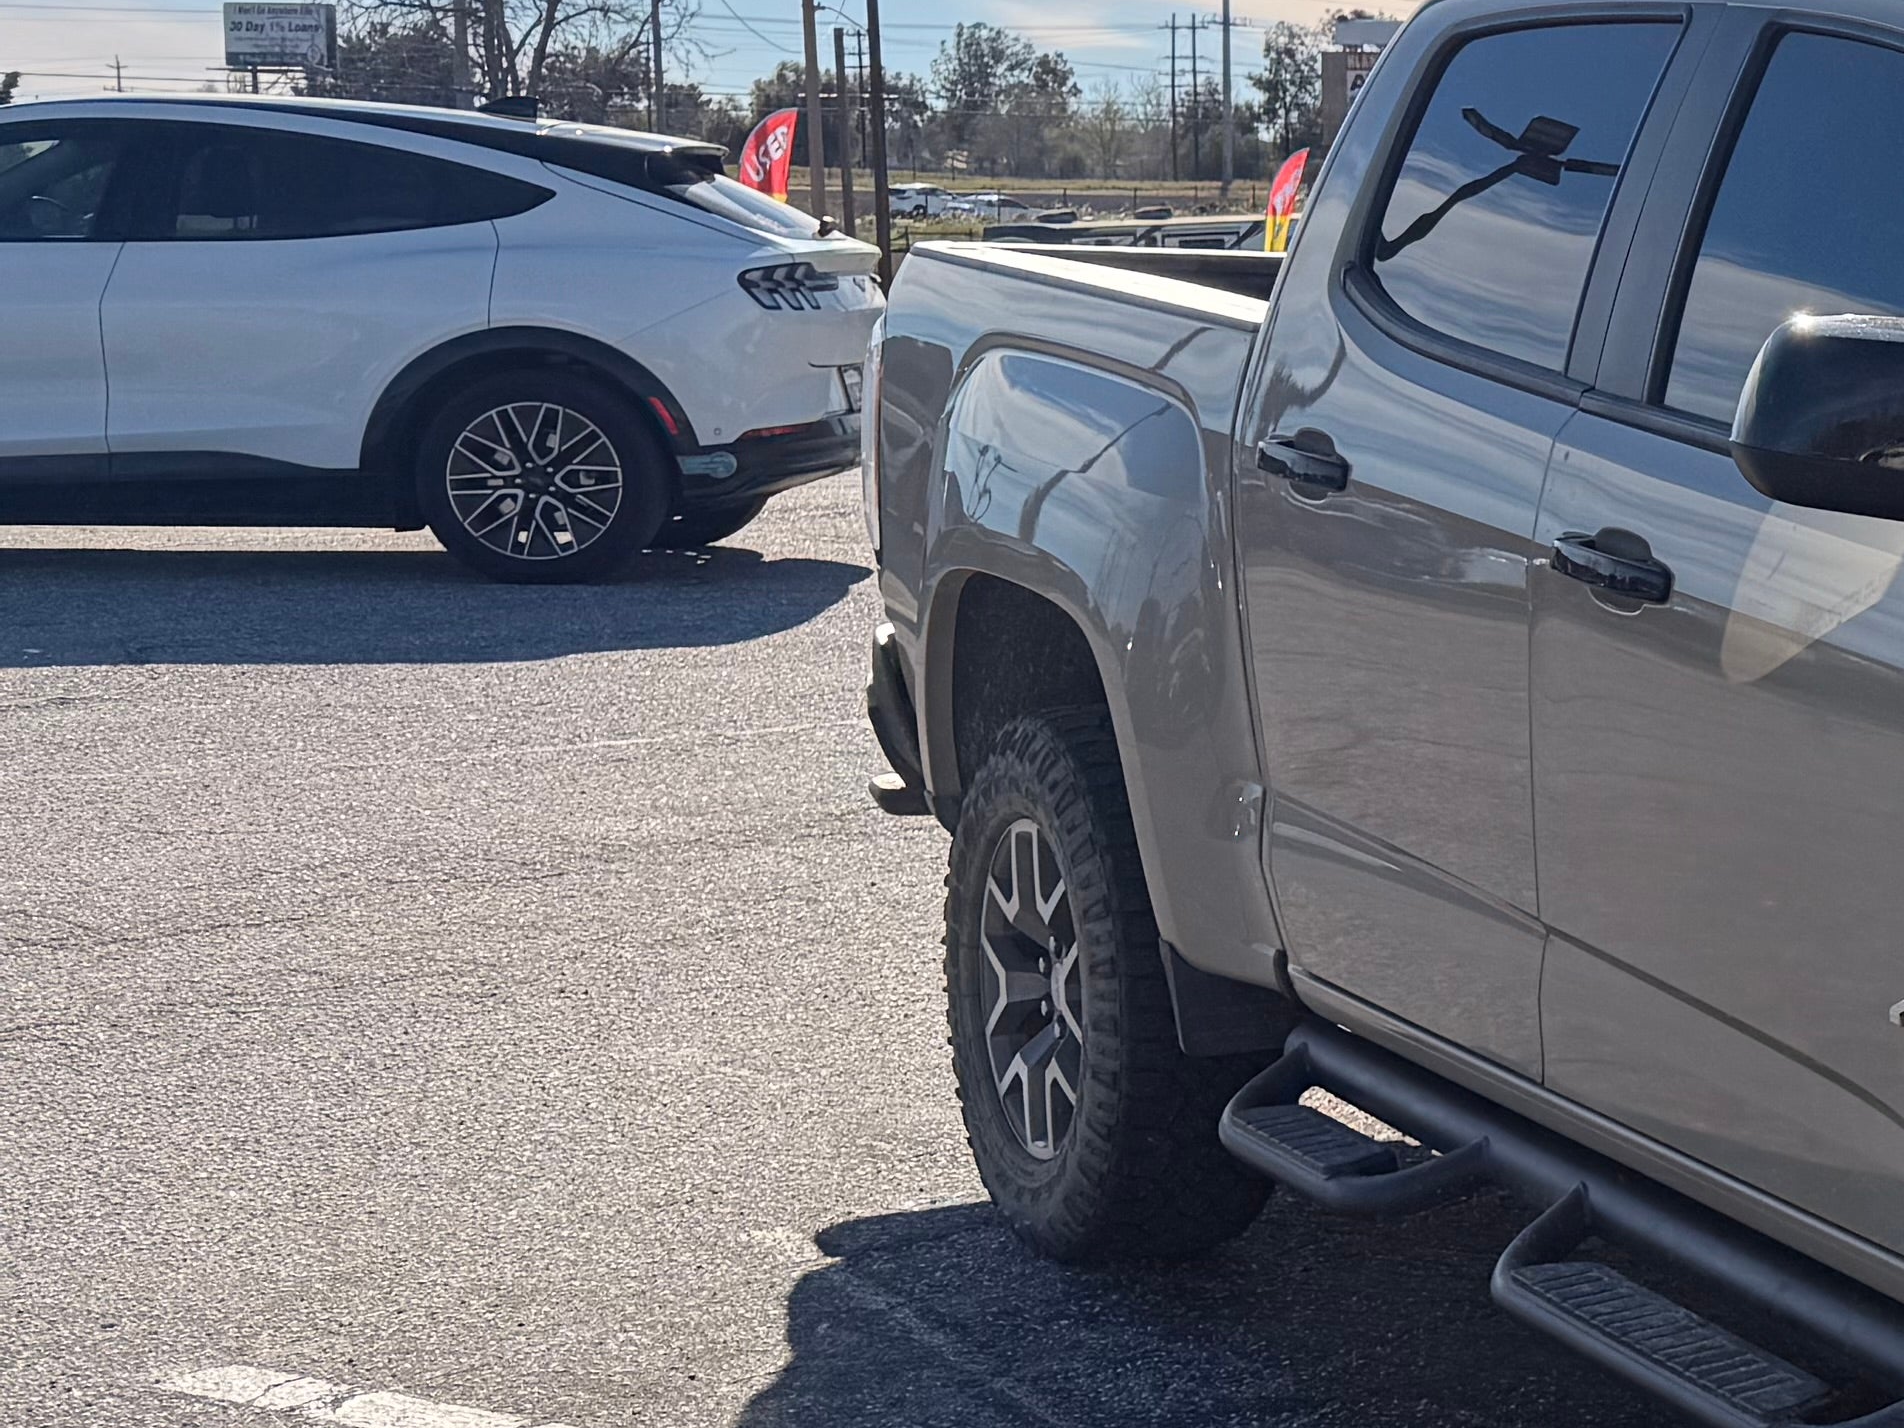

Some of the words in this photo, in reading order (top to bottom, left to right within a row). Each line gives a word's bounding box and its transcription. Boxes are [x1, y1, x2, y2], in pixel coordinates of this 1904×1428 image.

[229, 21, 243, 32] 30
[245, 21, 265, 35] Day
[287, 22, 320, 33] Loans
[743, 125, 789, 183] USED
